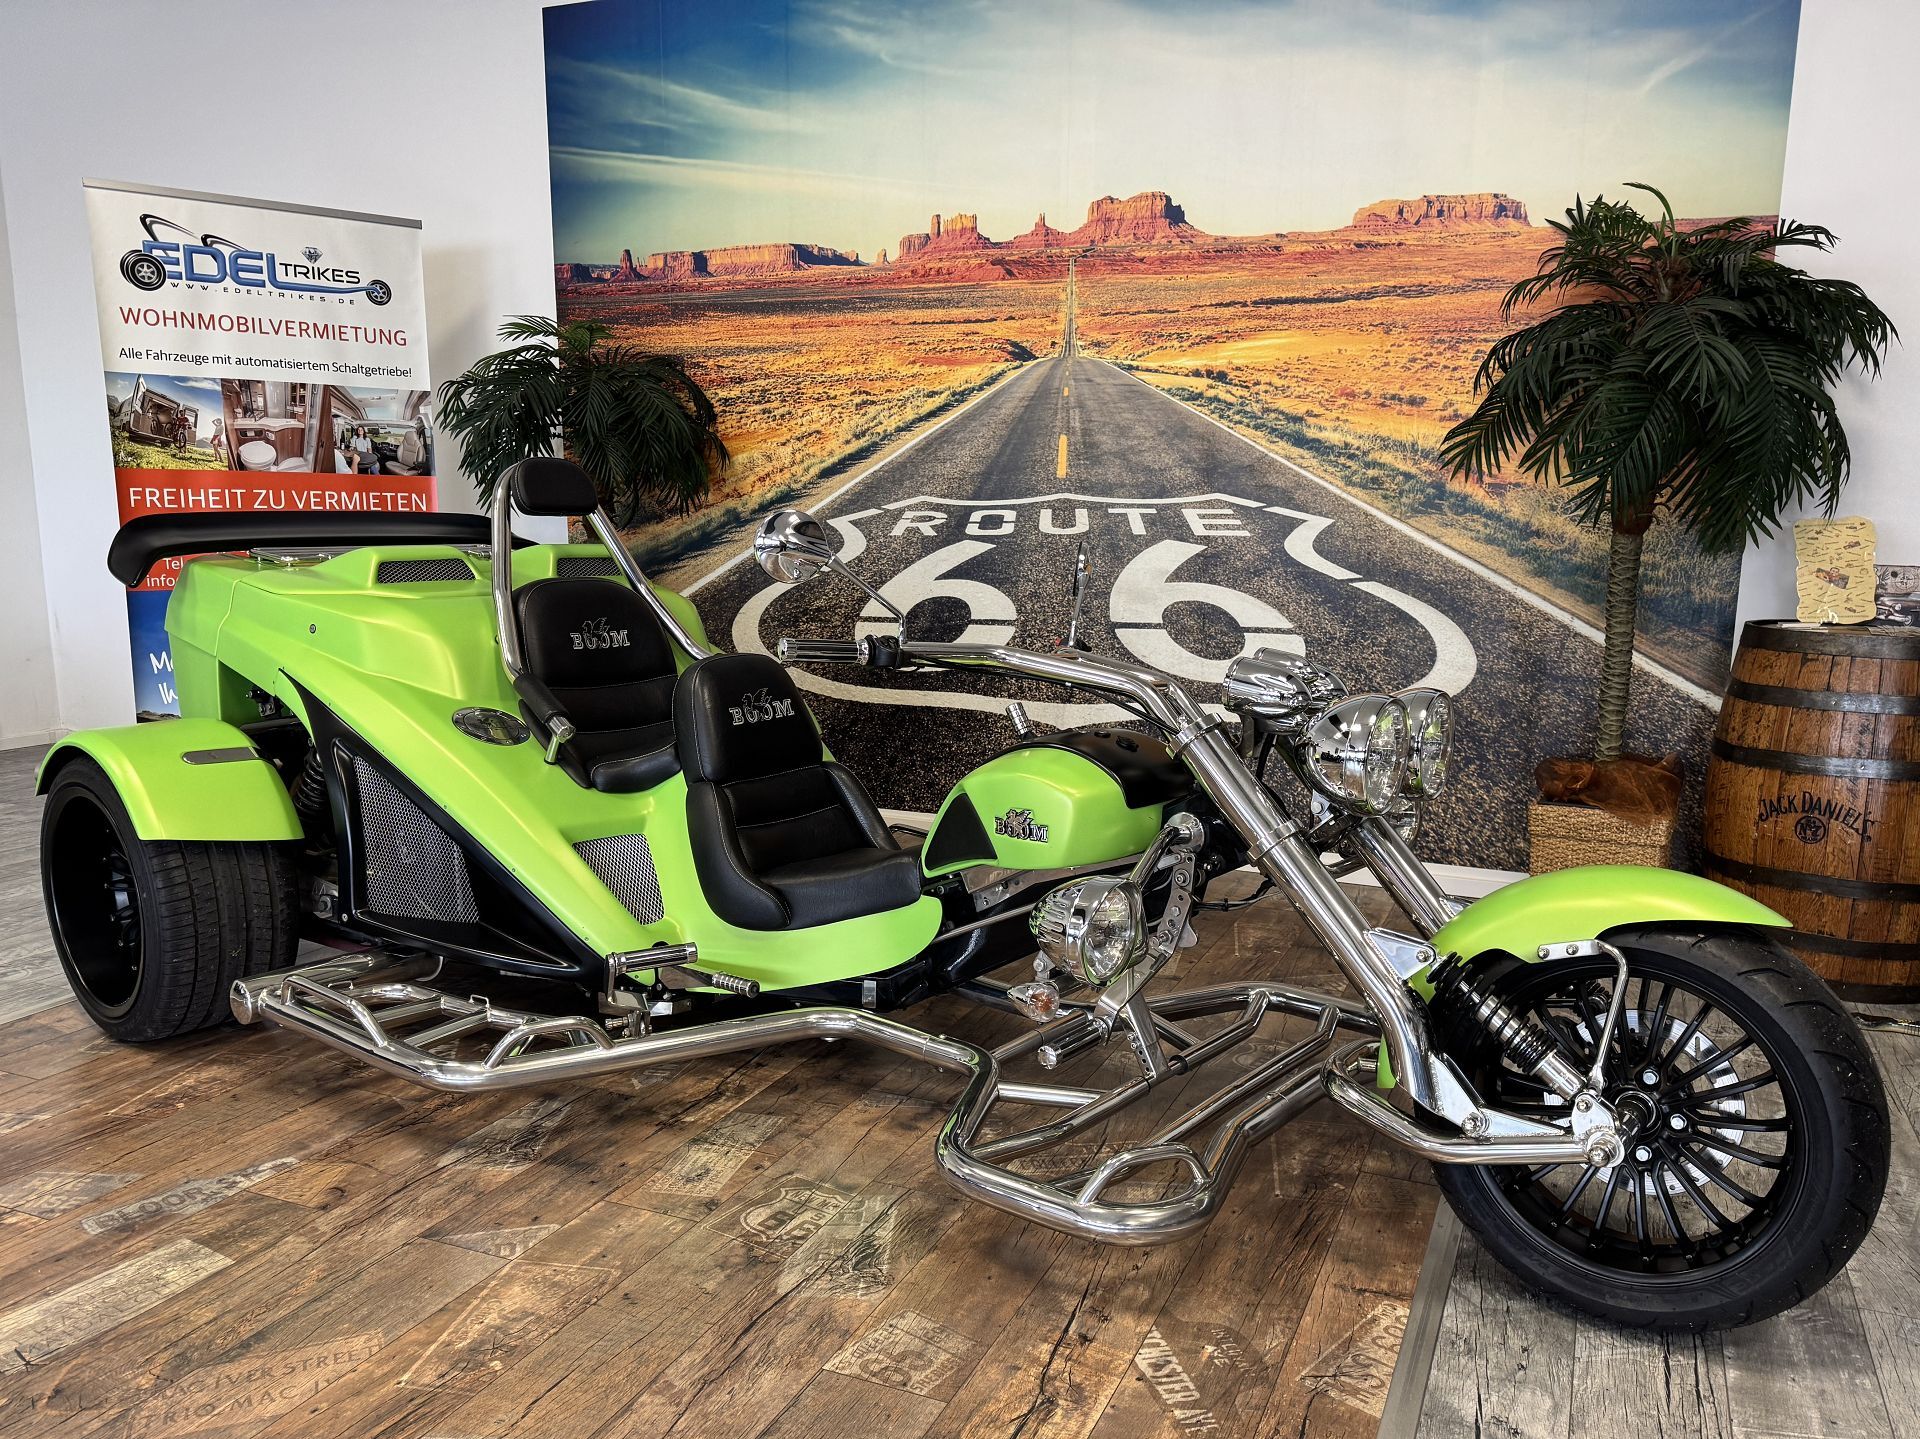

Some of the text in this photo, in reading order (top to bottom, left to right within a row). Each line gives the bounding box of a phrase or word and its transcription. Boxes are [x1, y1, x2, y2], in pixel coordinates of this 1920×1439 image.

[142, 240, 361, 292] EDEL TRIKES
[119, 306, 408, 347] WOHNMOBILVERMIETUNG
[119, 346, 412, 378] Alle Fahrzeuge mit automatisiertem Schaltgetriebe!
[129, 487, 428, 512] FREIHEIT ZU VERMIETEN
[890, 507, 1251, 536] ROUTE
[146, 575, 178, 587] info
[854, 538, 1307, 684] 66
[570, 629, 631, 651] BOOM
[729, 698, 795, 726] BOOM
[1759, 794, 1799, 822] JACK
[995, 816, 1049, 843] BOOM
[283, 1349, 376, 1376] STREET
